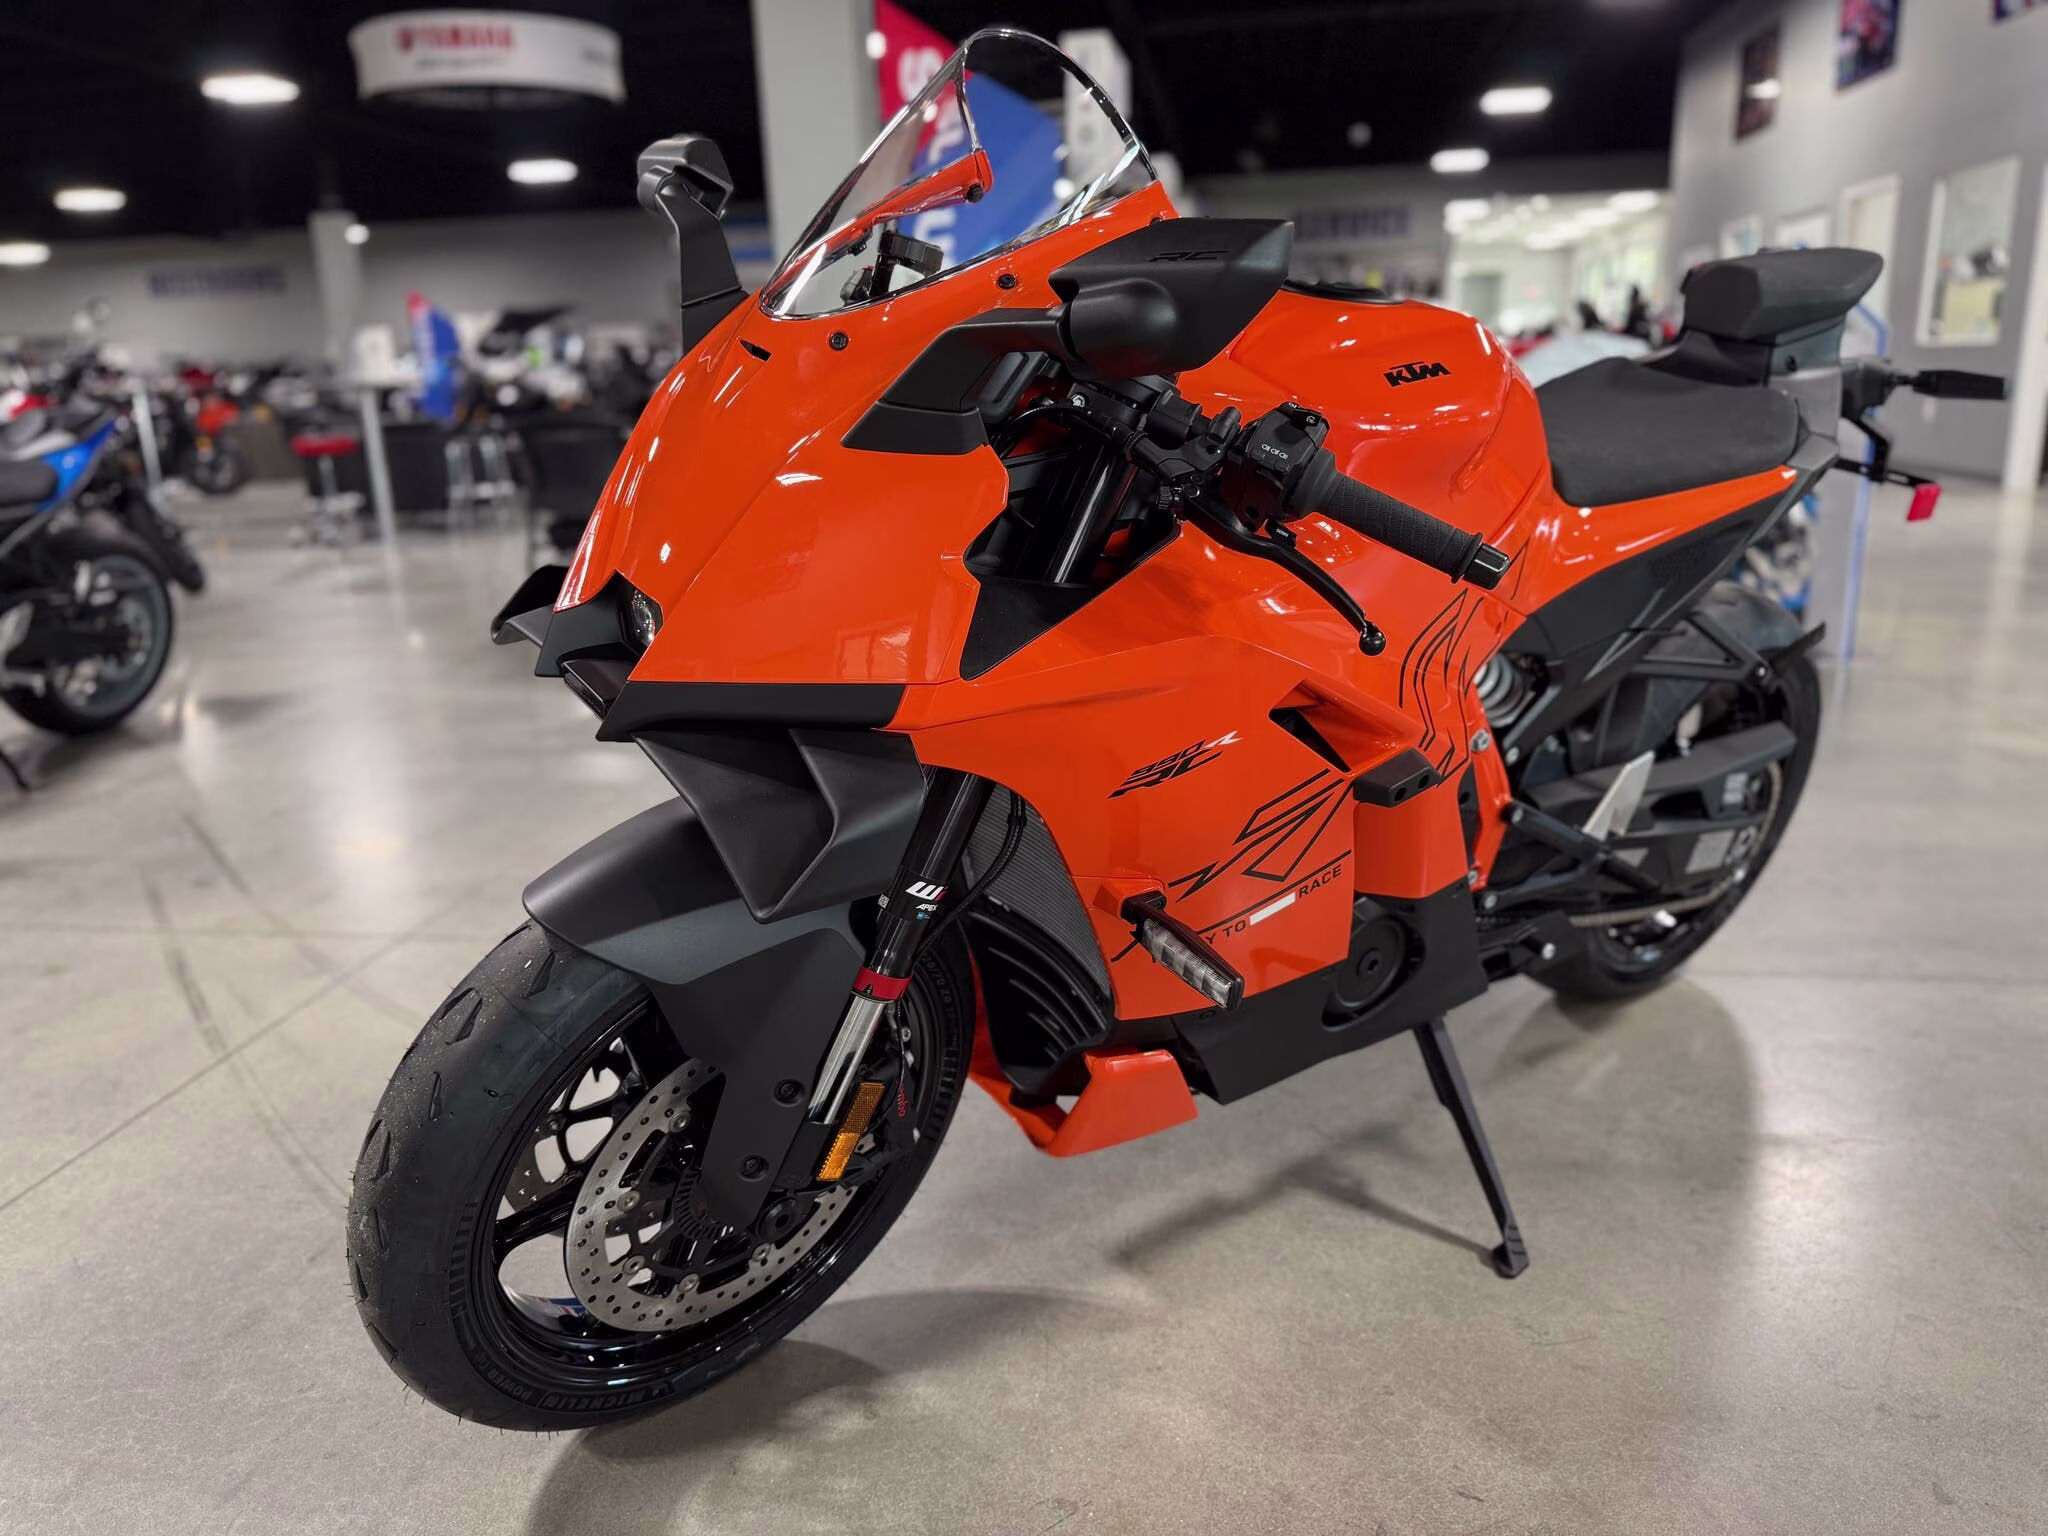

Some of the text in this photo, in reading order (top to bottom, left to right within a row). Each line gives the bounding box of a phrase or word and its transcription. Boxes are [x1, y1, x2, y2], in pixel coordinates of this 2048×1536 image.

[1383, 361, 1452, 387] KTM
[1222, 864, 1342, 938] TO RACE
[543, 1389, 645, 1411] MICHELIN
